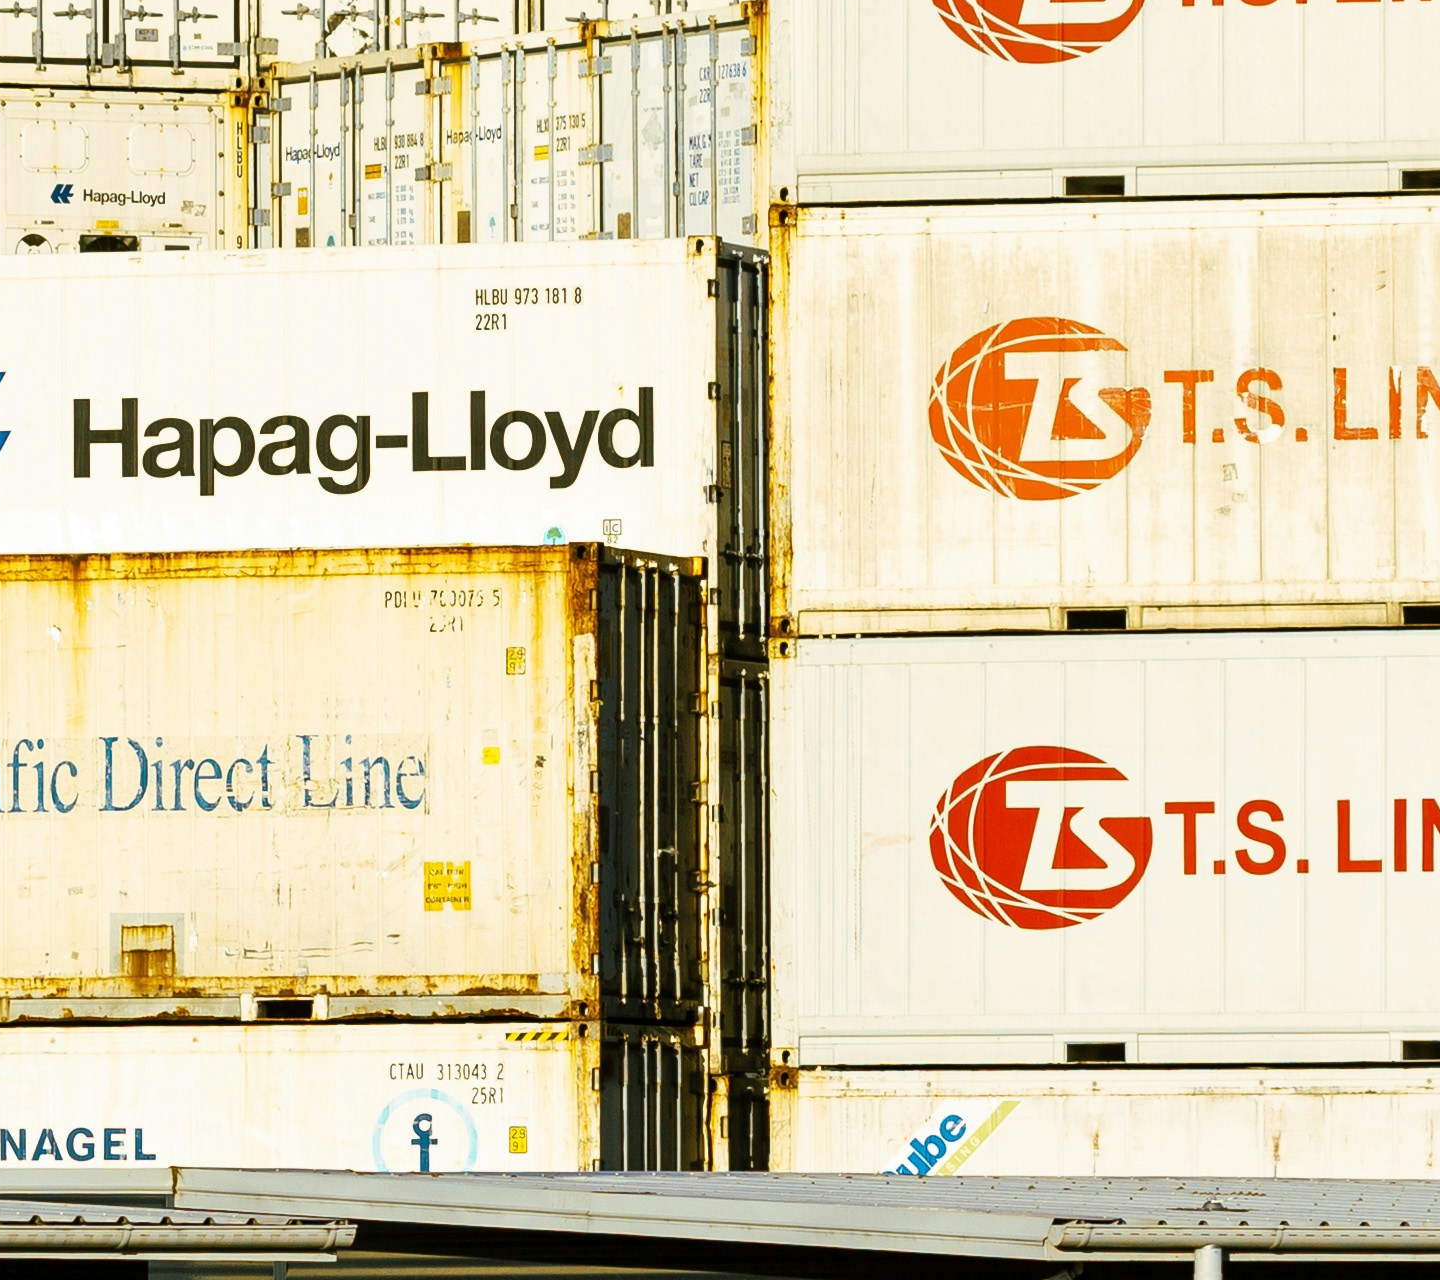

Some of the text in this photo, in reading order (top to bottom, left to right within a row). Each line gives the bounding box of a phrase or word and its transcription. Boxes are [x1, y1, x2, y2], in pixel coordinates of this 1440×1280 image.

[83, 190, 166, 207] Hapag-Lloyd
[475, 287, 582, 305] HLBU 973 181 8
[475, 314, 508, 330] 22R1
[1163, 367, 1308, 446] T.S.
[72, 387, 655, 496] Hapag-Lloyd
[99, 736, 274, 816] Direct
[295, 732, 427, 811] Line
[1164, 800, 1309, 877] T.S.
[389, 1062, 504, 1081] CTAU 313043 2
[471, 1087, 504, 1104] 25R1
[0, 1128, 157, 1161] NAGEL
[883, 1108, 968, 1175] ube
